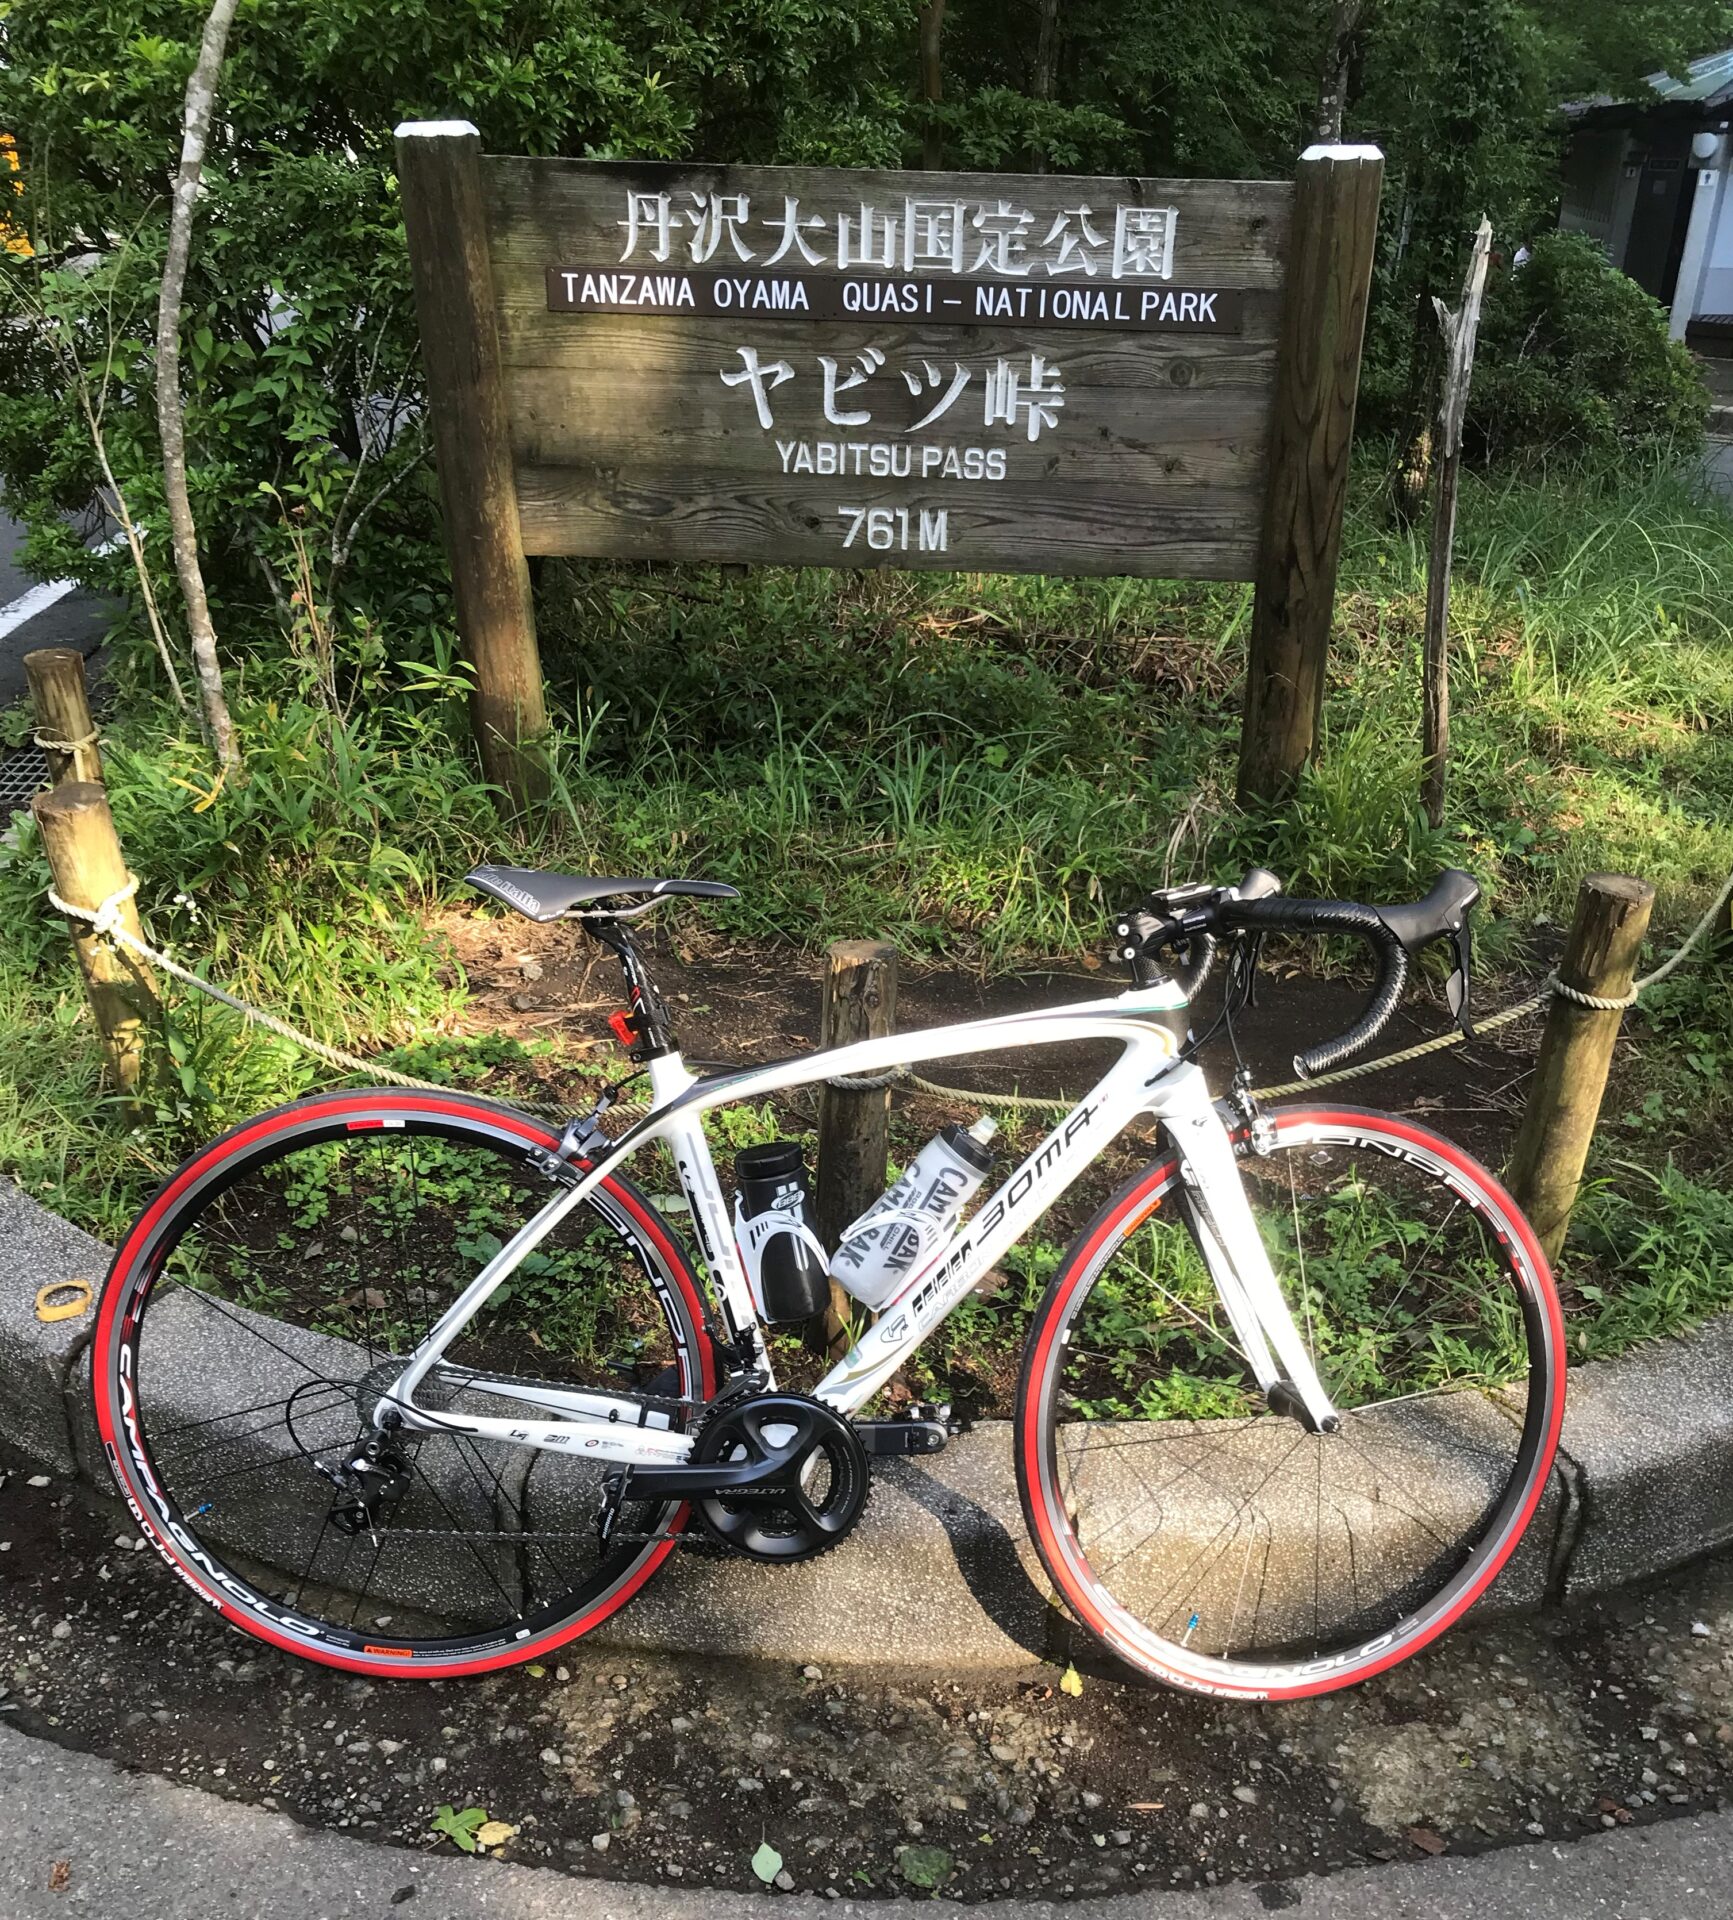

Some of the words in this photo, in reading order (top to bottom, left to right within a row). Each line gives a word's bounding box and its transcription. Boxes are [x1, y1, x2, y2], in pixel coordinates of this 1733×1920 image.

[617, 188, 1178, 281] 丹沢大山国定公園
[561, 272, 696, 308] TANZAWA
[713, 278, 810, 311] OYAMA
[1140, 292, 1219, 323] PARK
[719, 346, 1067, 442] ヤビツ峠
[775, 440, 911, 478] YABITSU
[922, 445, 1007, 481] PASS
[777, 1191, 802, 1209] BBB
[883, 1166, 968, 1269] CAMBAK
[119, 1343, 321, 1637] CAMPAGNOLO
[715, 1487, 788, 1496] ULTEGRA
